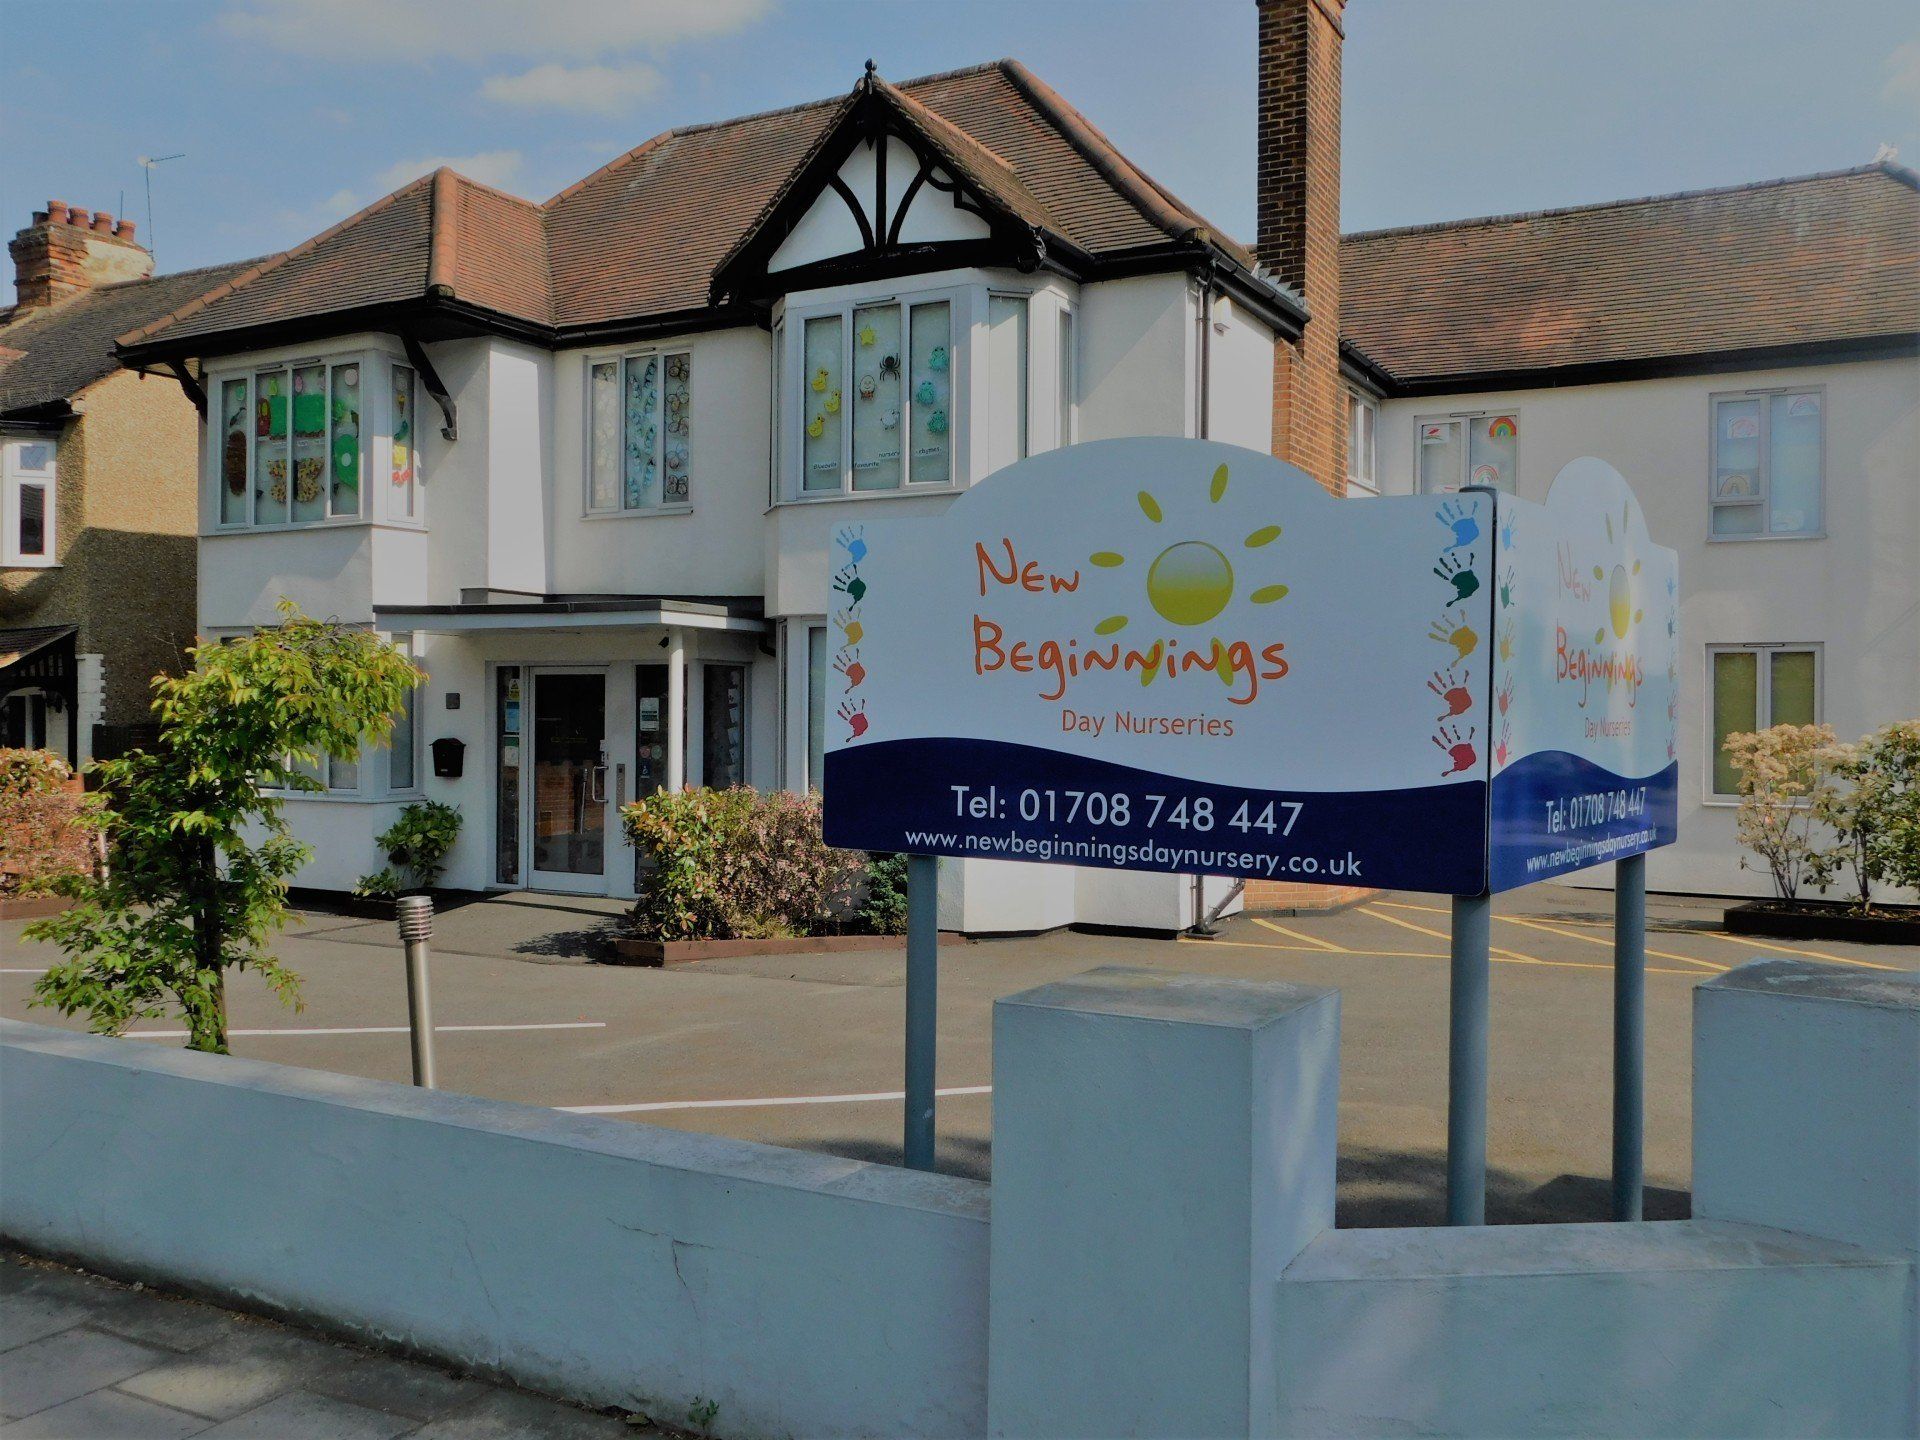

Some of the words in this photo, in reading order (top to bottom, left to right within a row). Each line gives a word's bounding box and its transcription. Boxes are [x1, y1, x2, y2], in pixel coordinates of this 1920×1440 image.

[975, 538, 1080, 597] New
[973, 614, 1289, 705] Beginnings
[1556, 615, 1643, 708] Beginnings
[1061, 709, 1105, 738] Day
[1115, 711, 1234, 736] Nurseries
[1584, 716, 1598, 743] Day
[1600, 717, 1632, 738] Nurseries
[950, 784, 1006, 820] Tel:
[1019, 788, 1131, 827] 01708
[1145, 794, 1215, 832] 748
[1227, 799, 1304, 837] 447
[1545, 800, 1566, 834] Tel:
[1569, 793, 1605, 830] 01708
[1607, 789, 1626, 822] 748
[1628, 786, 1646, 816] 447
[905, 830, 1362, 877] www.newbeginningsdaynursery.co.uk
[1526, 821, 1657, 874] www.newbeginningsdaynursery.co.uk
